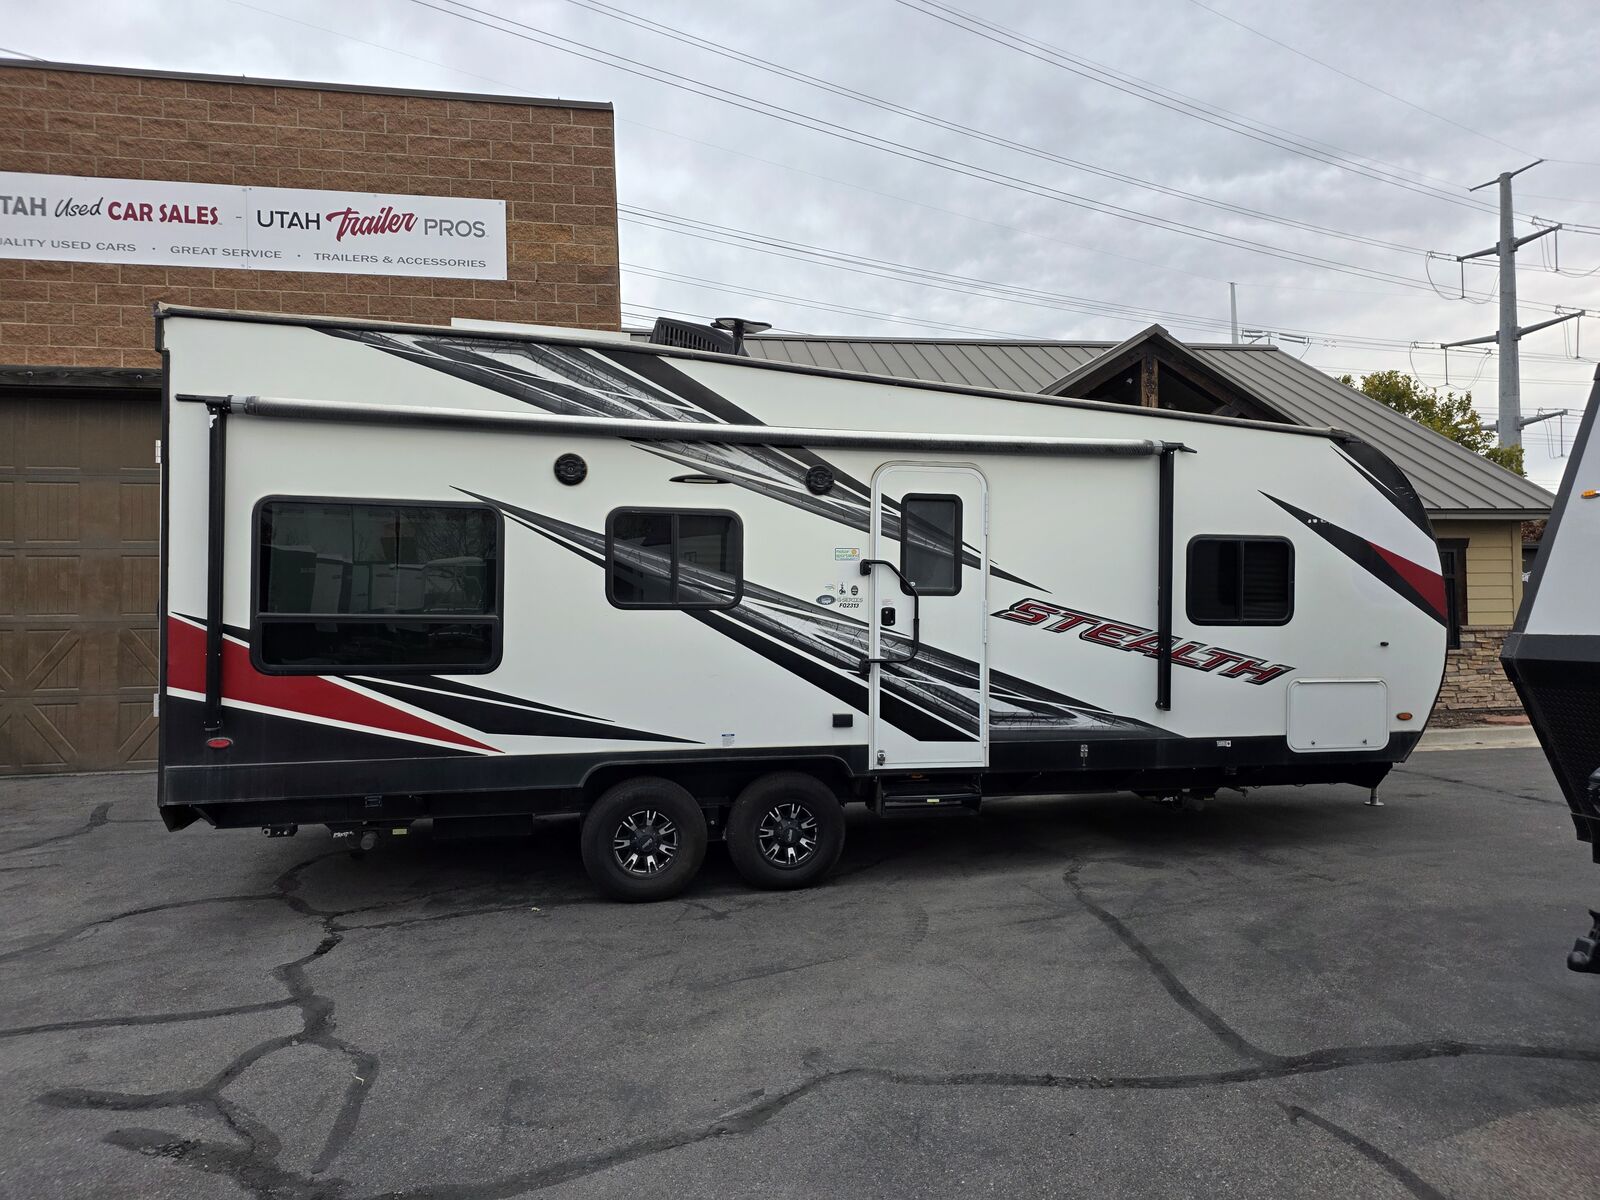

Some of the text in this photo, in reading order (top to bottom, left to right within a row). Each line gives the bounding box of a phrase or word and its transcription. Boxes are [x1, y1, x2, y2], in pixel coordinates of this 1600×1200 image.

[54, 196, 104, 218] Used
[107, 201, 154, 222] CAR
[159, 203, 219, 225] SALES
[256, 209, 321, 231] UTAH
[424, 218, 486, 239] PROS
[0, 237, 137, 252] ALITY USED CARS
[170, 245, 282, 259] GREAT SERVICE
[313, 252, 487, 268] TRAILERS & ACCESSORIES
[990, 597, 1296, 686] STEALTH
